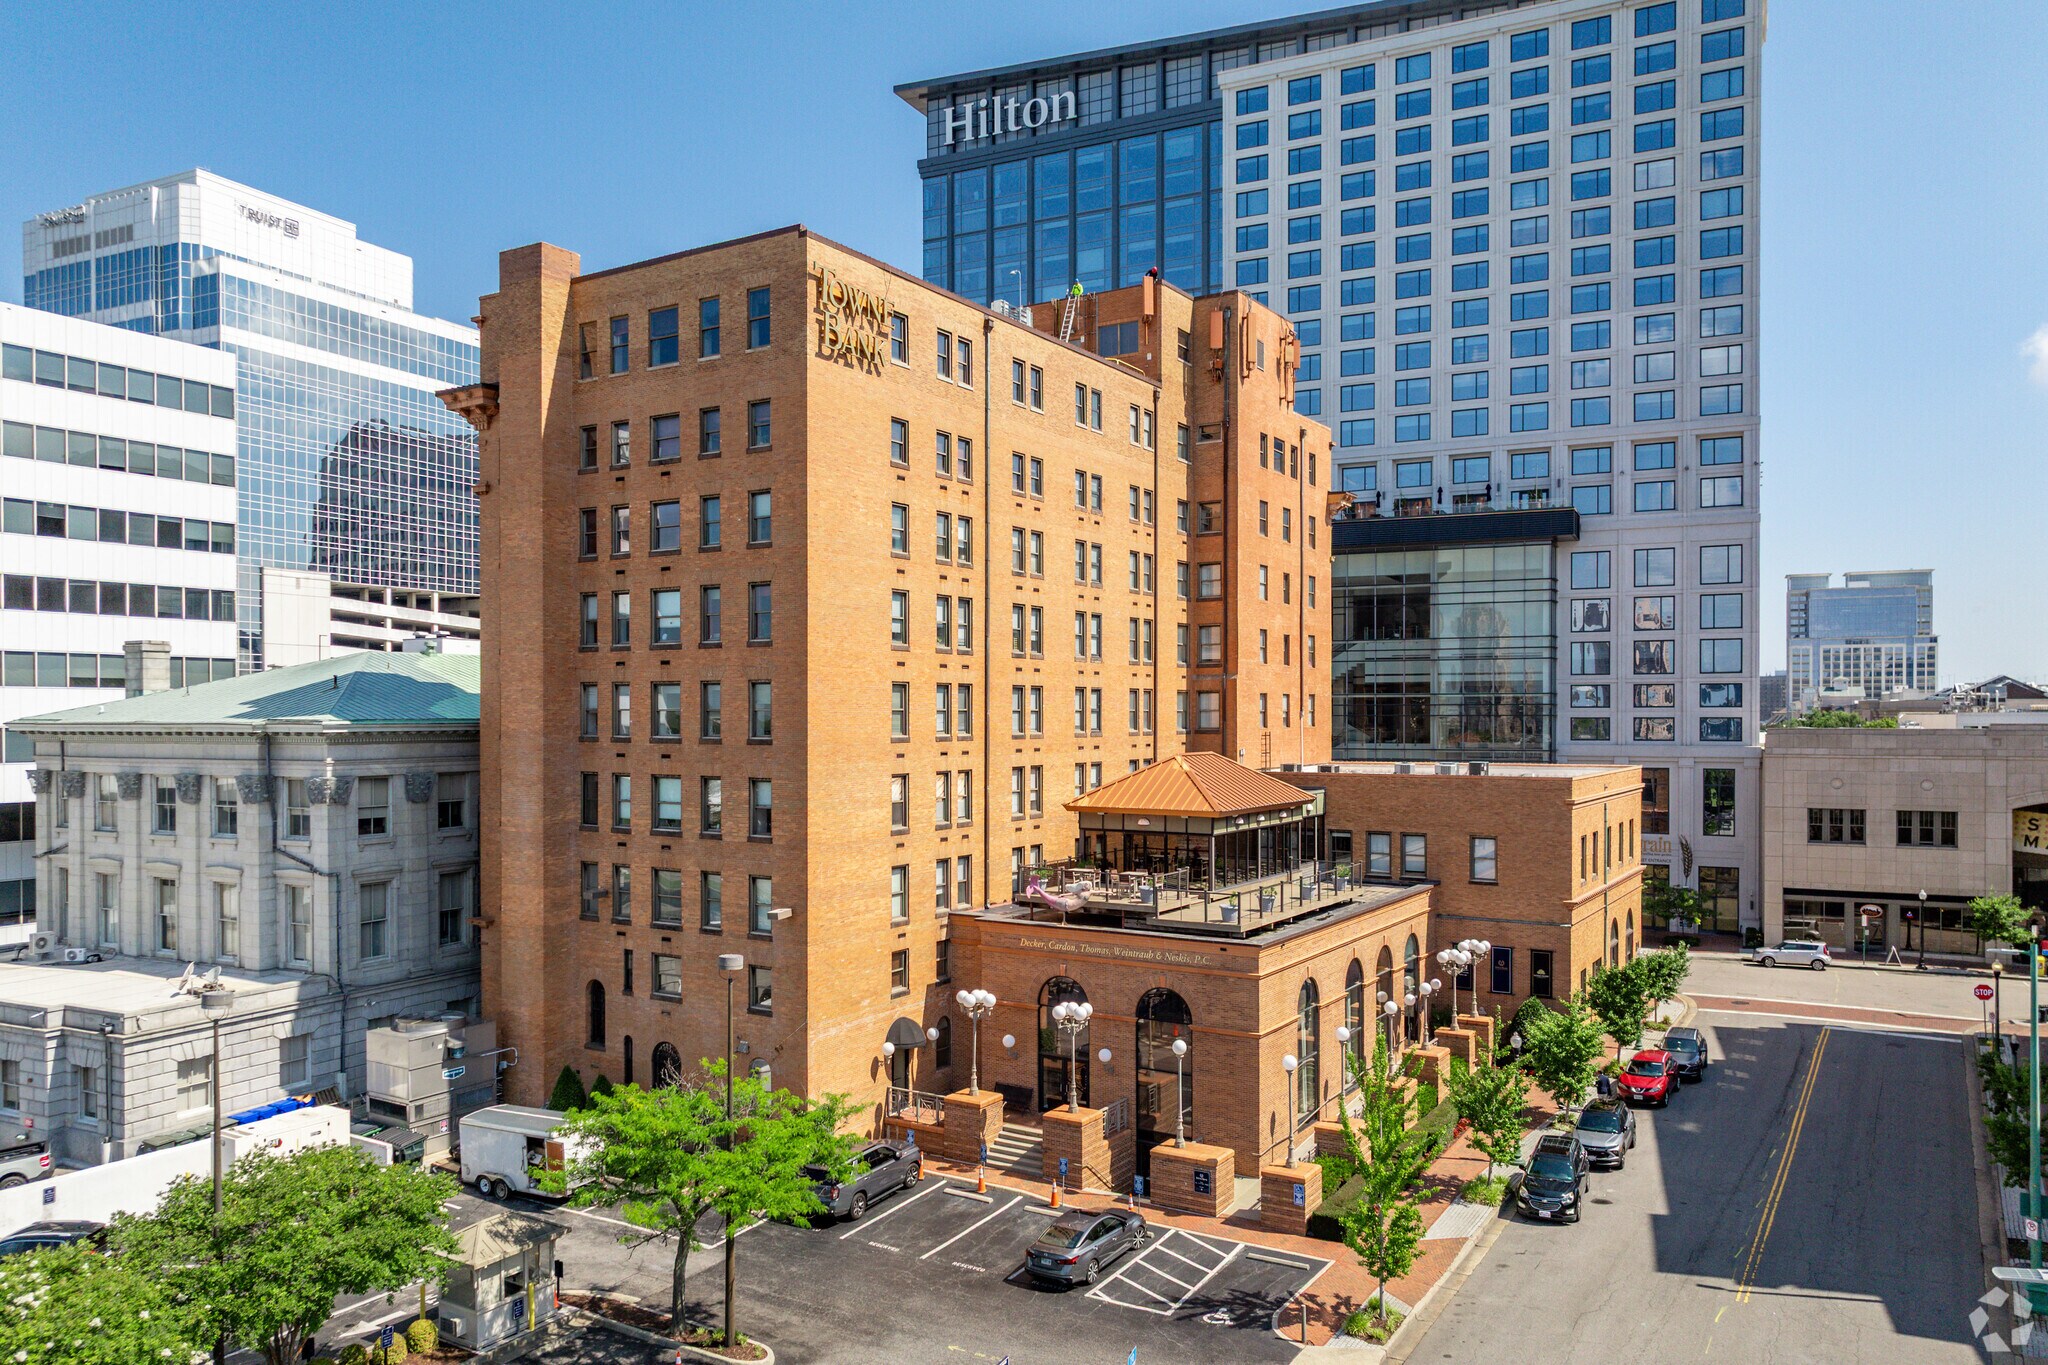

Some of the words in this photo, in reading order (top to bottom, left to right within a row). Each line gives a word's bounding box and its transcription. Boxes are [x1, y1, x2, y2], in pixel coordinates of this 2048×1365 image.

[943, 89, 1077, 146] Hilton
[239, 204, 283, 229] TRUIST
[813, 260, 896, 331] TOWNE
[822, 310, 887, 369] BANK
[1641, 837, 1672, 852] rain
[1020, 938, 1047, 949] Decker,
[1048, 940, 1078, 953] Cardon,
[1080, 943, 1111, 955] Thomas,
[1113, 946, 1154, 959] Weintraub
[1155, 951, 1163, 960] &
[1164, 952, 1192, 964] Neskis,
[1194, 955, 1212, 965] P.C.
[1974, 988, 1993, 996] STOP
[867, 1241, 900, 1251] RESERVED
[951, 1261, 986, 1272] RESERVED
